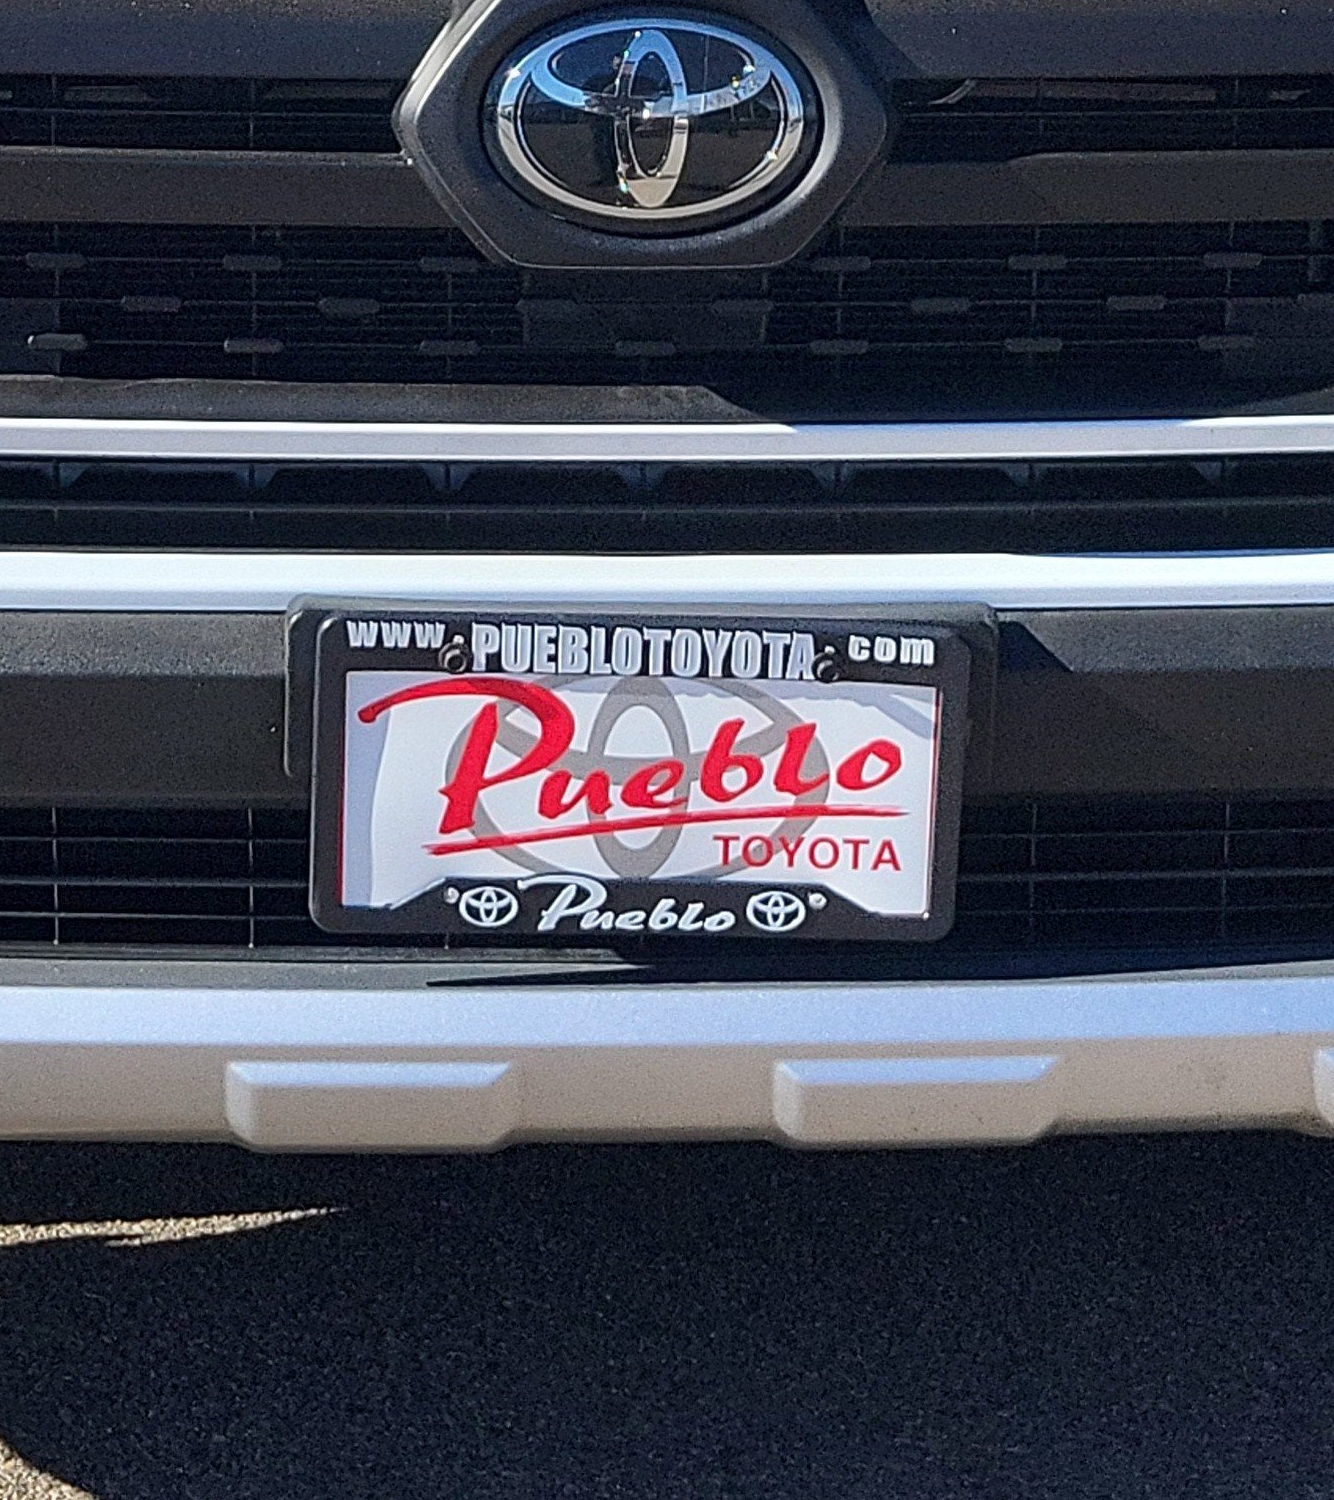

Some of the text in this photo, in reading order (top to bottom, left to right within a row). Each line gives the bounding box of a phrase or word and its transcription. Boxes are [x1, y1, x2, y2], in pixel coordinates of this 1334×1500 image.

[359, 676, 903, 834] Pueblo
[713, 836, 902, 872] TOYOTA
[517, 874, 737, 932] Pueblo
